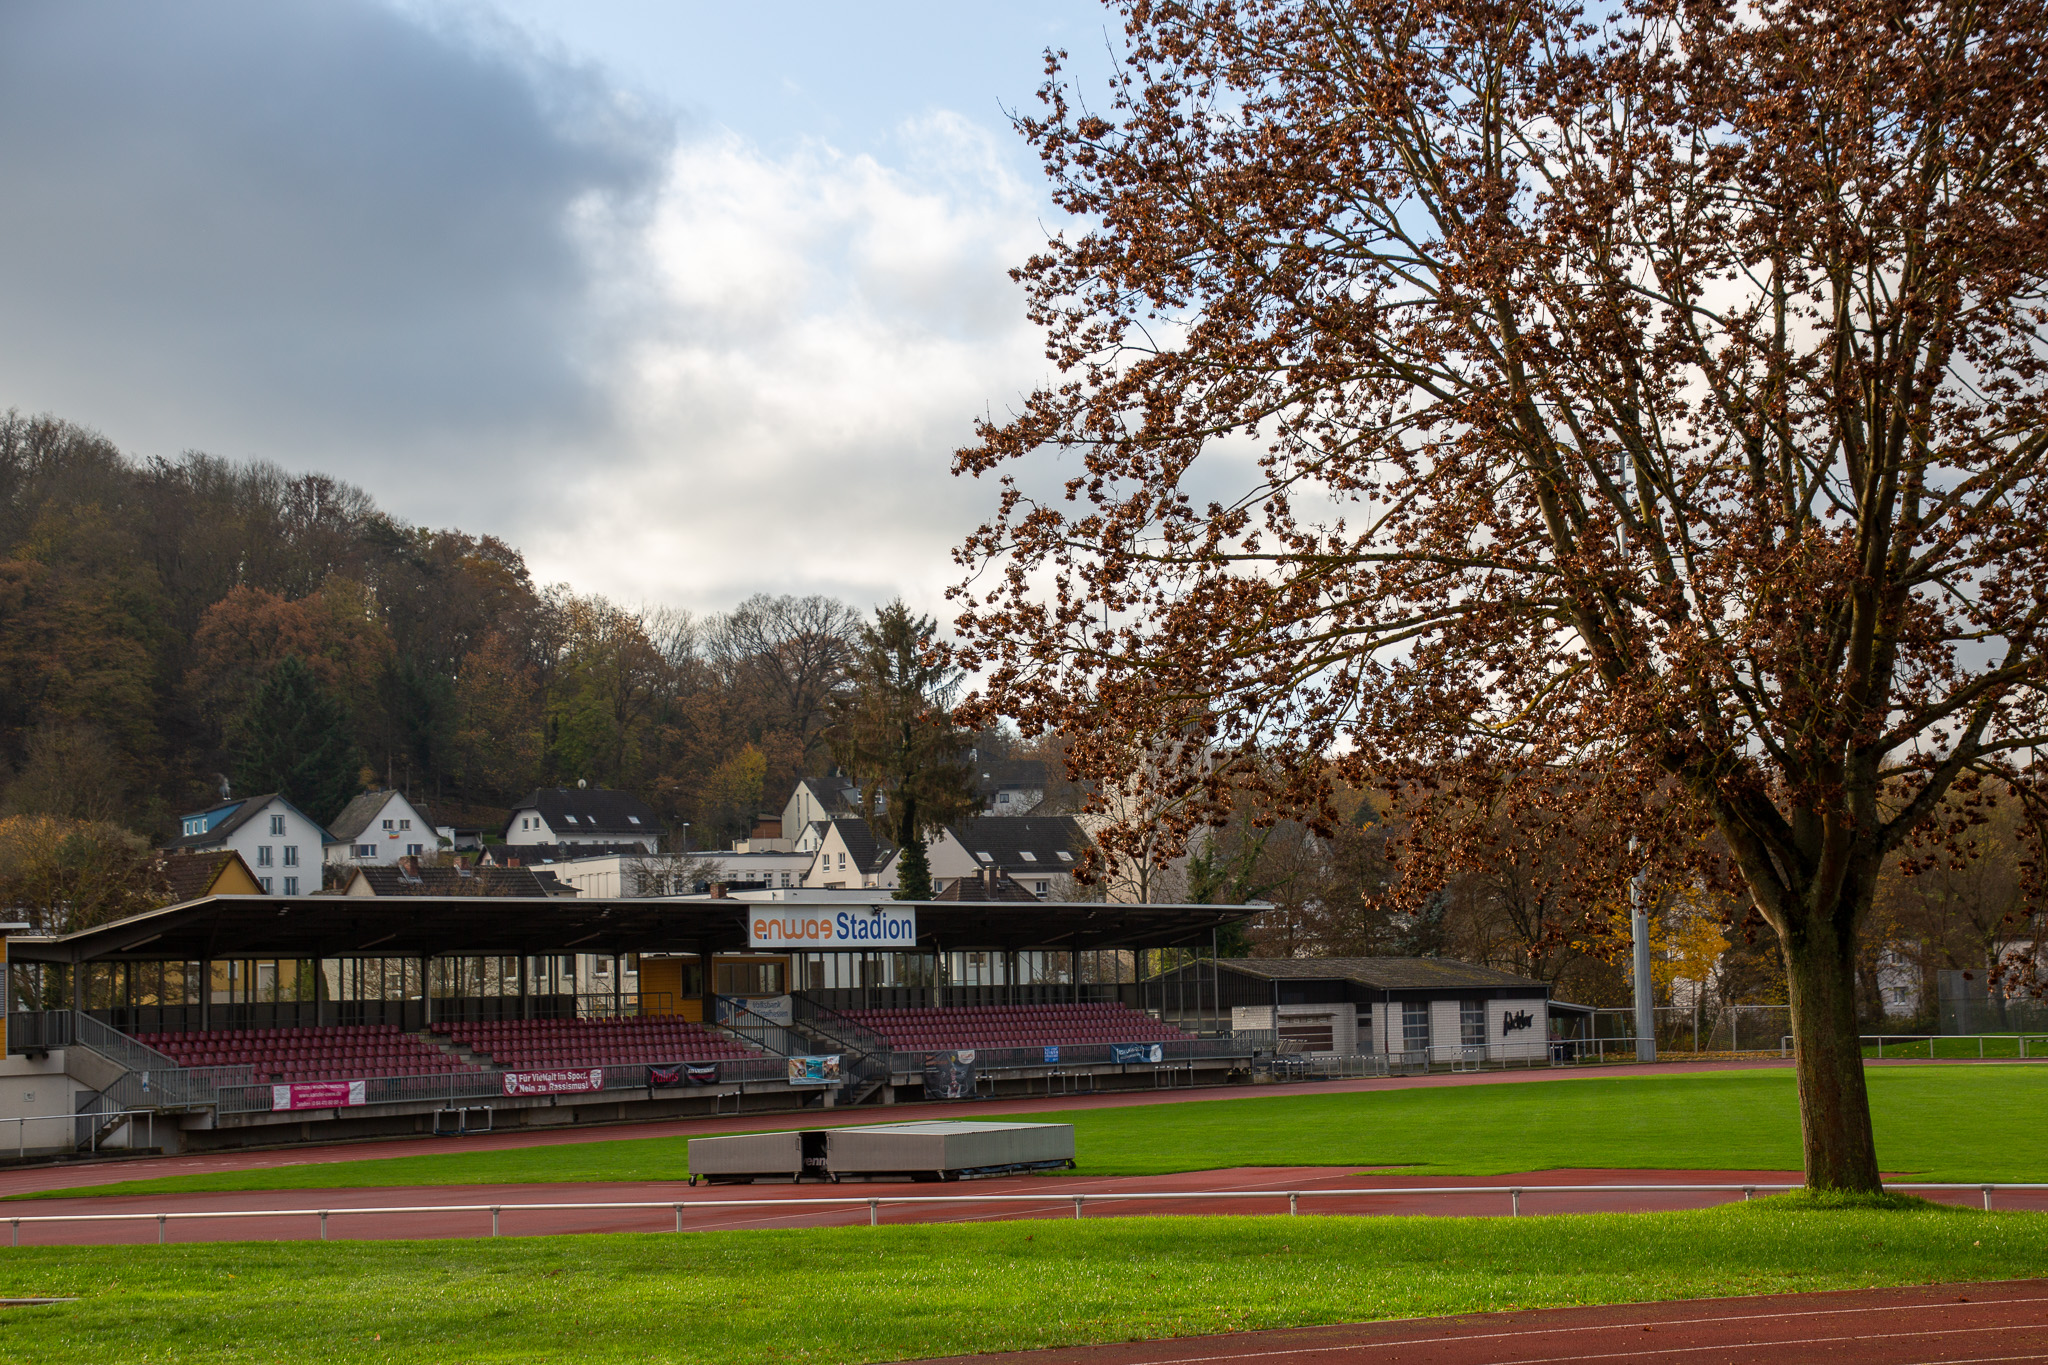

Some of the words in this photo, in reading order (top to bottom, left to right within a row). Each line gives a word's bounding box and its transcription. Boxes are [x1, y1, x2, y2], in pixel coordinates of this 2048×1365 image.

[836, 912, 913, 940] Stadion
[752, 1001, 781, 1009] Volksbank
[518, 1074, 531, 1083] Für
[532, 1072, 557, 1081] Vielfalt
[557, 1072, 567, 1080] im
[651, 1069, 679, 1083] Palais
[519, 1084, 536, 1092] Nein
[537, 1084, 547, 1092] zu
[548, 1081, 589, 1091] Rassismus!
